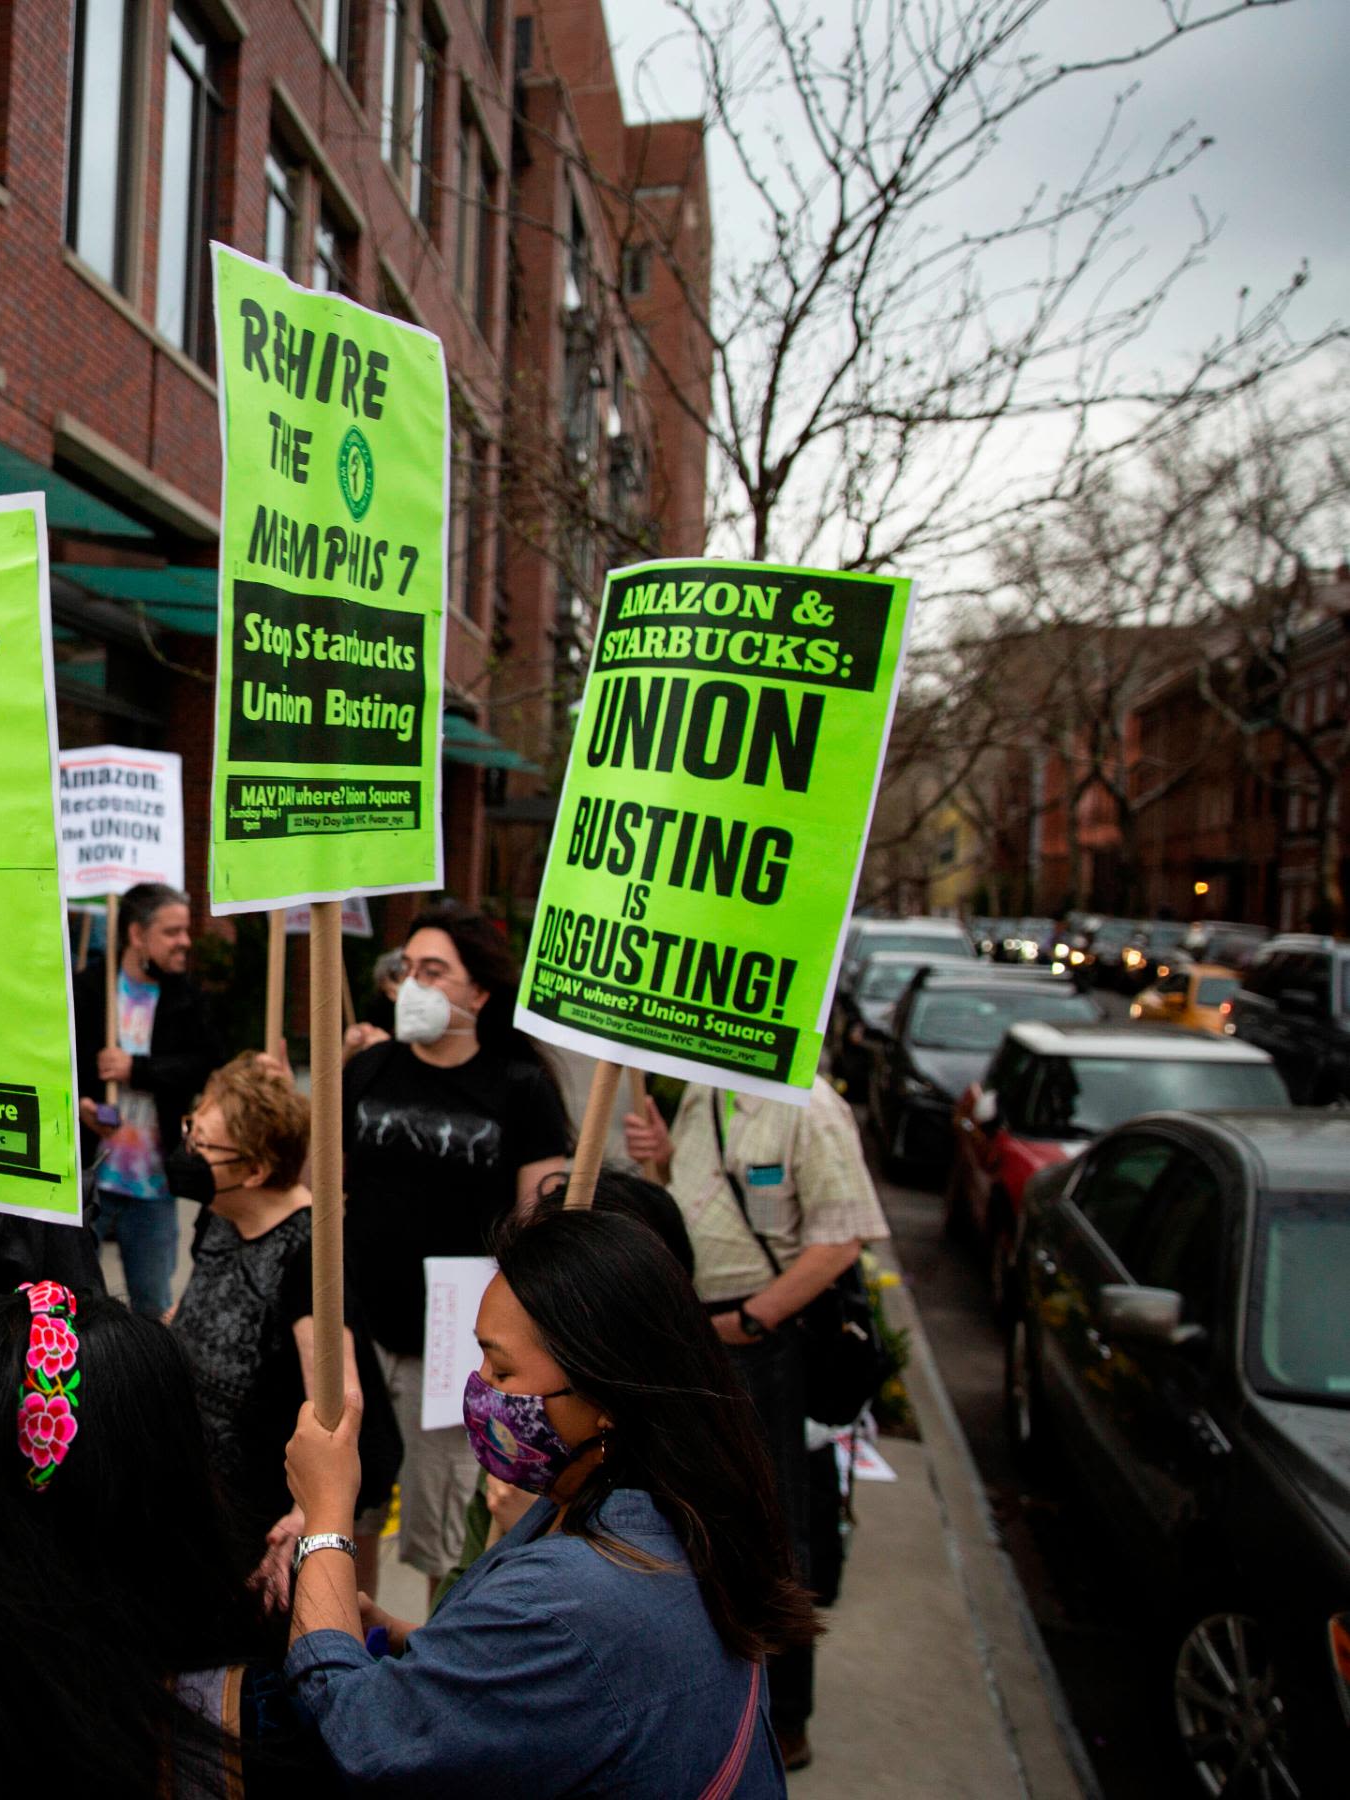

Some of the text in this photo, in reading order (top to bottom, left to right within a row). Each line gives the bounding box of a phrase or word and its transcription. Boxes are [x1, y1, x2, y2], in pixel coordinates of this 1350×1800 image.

[240, 297, 389, 420] REHIRE
[269, 410, 313, 484] THE
[247, 504, 419, 596] MEMPHIS 7
[617, 581, 834, 628] AMAZON &
[244, 612, 292, 668] Stop
[601, 625, 853, 678] STARBUCKS:
[242, 680, 312, 725] Union
[587, 676, 826, 794] UNION
[241, 785, 276, 806] MAY
[369, 785, 410, 807] Square
[91, 817, 161, 843] UNION
[567, 796, 793, 906] BUSTING
[621, 882, 650, 920] IS
[536, 904, 798, 1020] DISGUSTING!
[555, 974, 582, 996] DAY
[583, 985, 638, 1012] where?
[642, 999, 699, 1028] Union
[704, 1014, 776, 1045] Square
[671, 1033, 694, 1047] NYC
